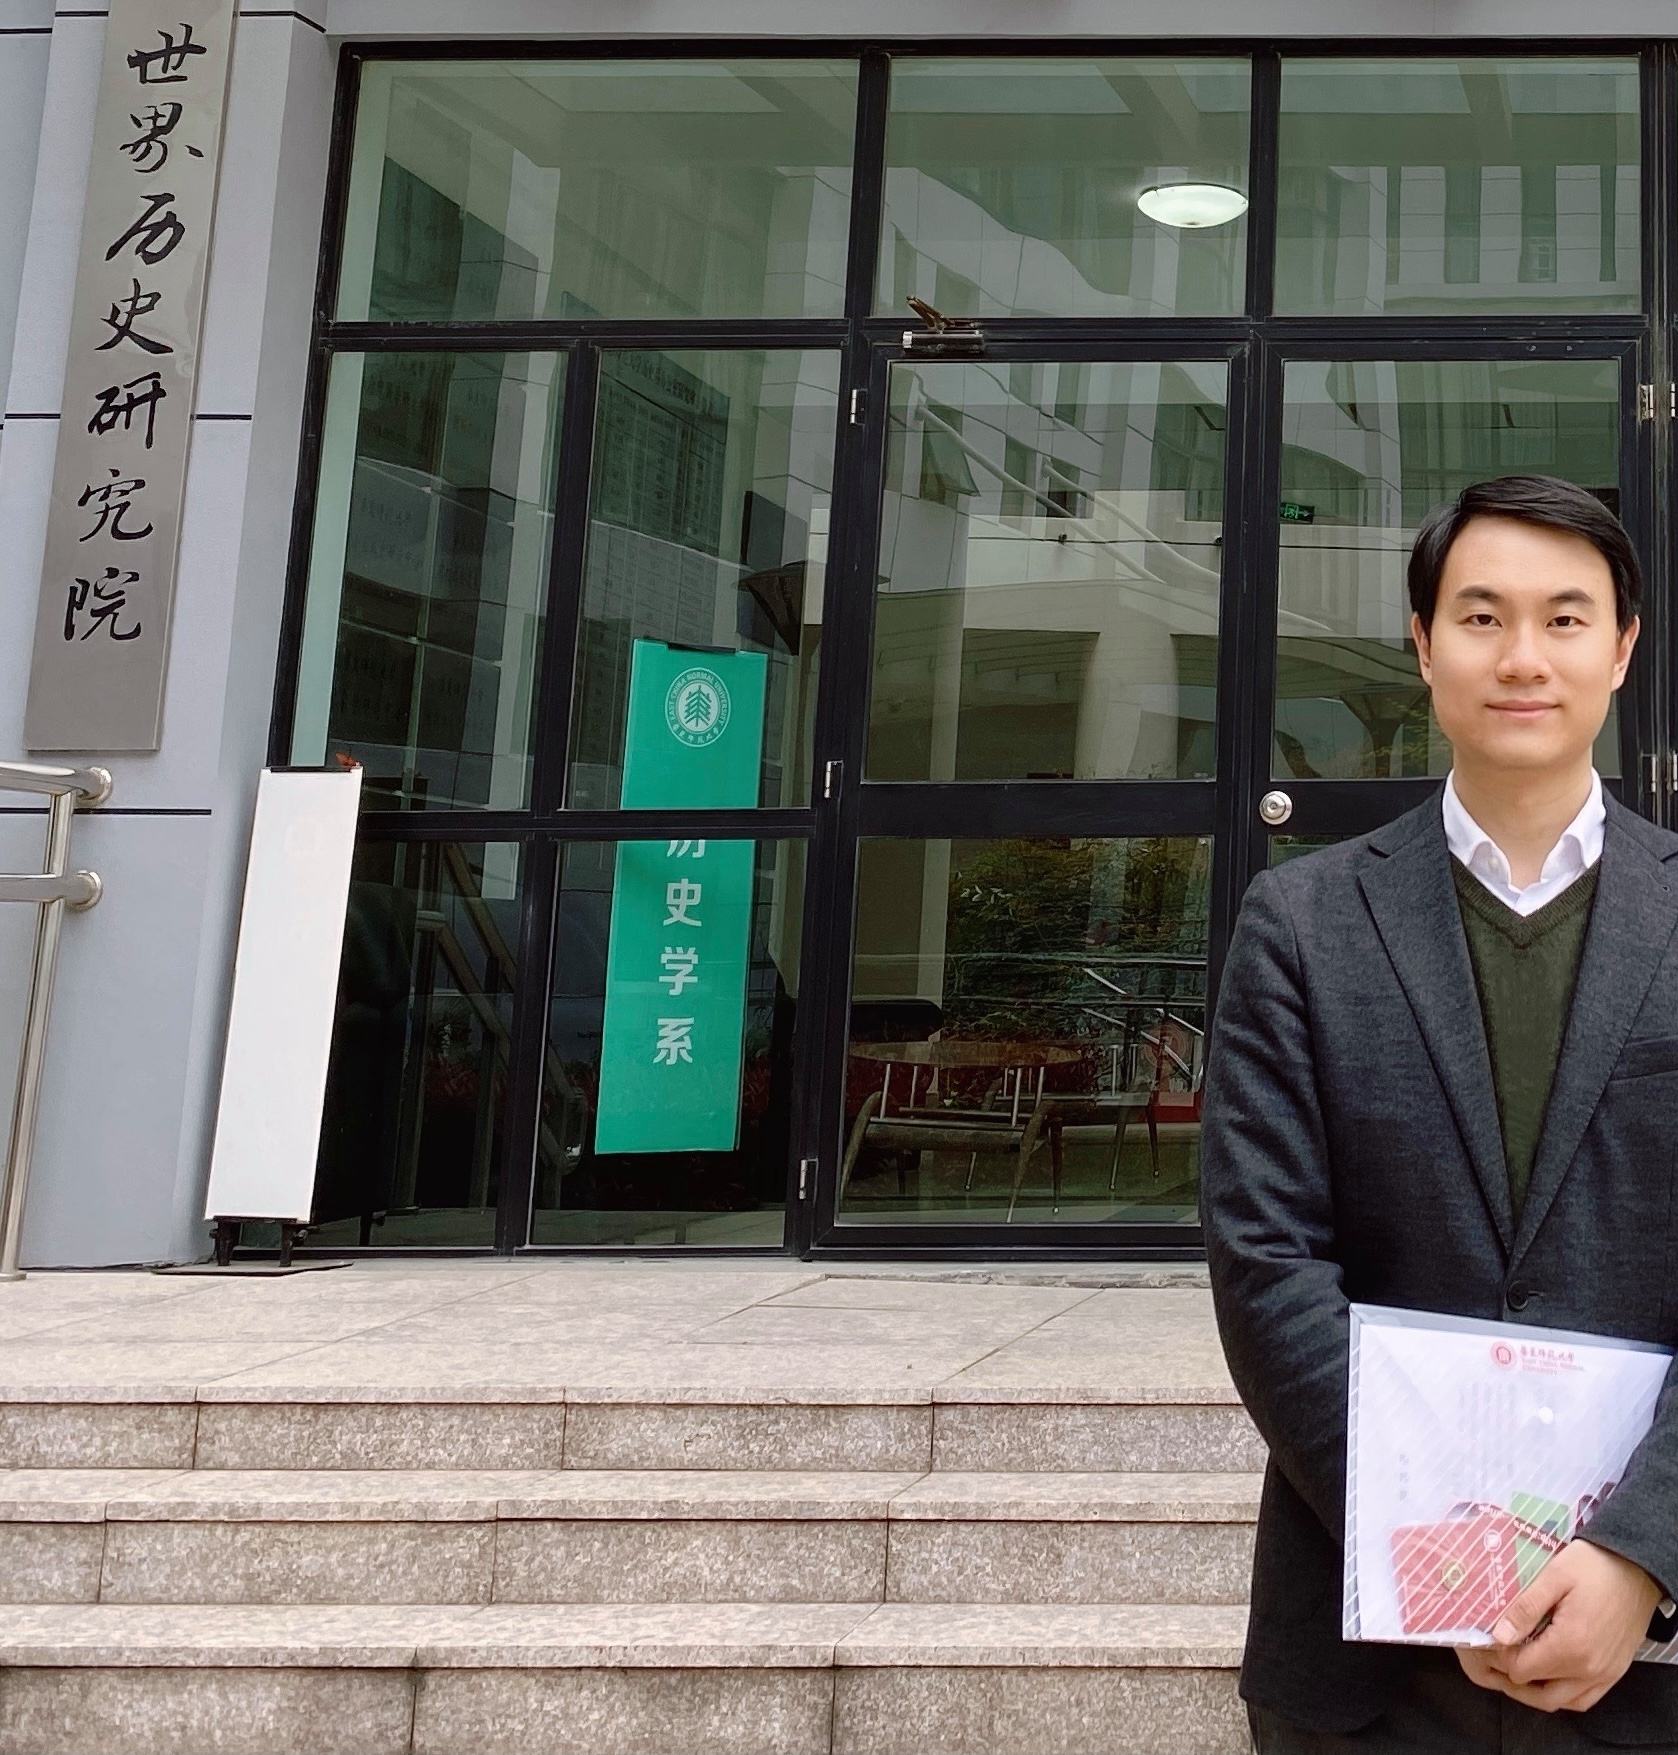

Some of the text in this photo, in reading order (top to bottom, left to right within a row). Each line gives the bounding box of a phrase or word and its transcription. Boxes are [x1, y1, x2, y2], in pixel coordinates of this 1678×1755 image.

[64, 22, 207, 642] 世界历史研究院
